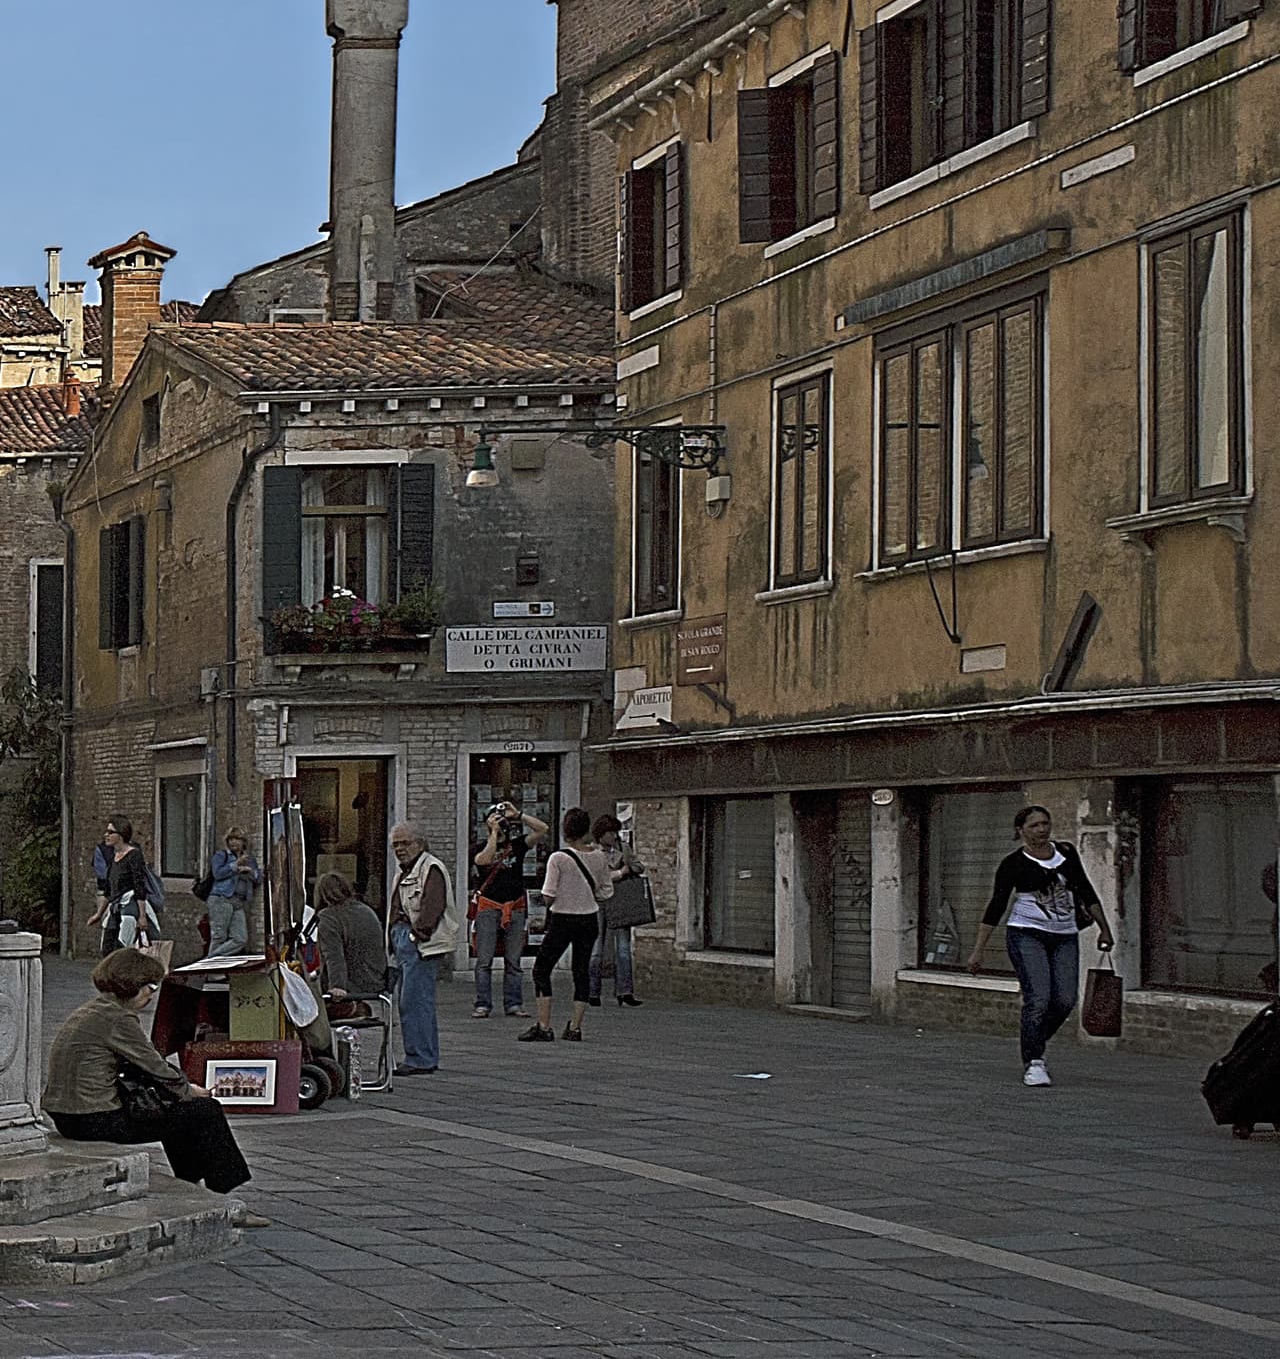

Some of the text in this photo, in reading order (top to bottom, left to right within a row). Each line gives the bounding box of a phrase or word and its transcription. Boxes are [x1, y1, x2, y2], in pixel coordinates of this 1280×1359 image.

[447, 629, 605, 642] CALLE DEL CAMPANIEL
[473, 644, 582, 655] DETTA CIVRAN
[484, 657, 572, 669] O GRIMANI
